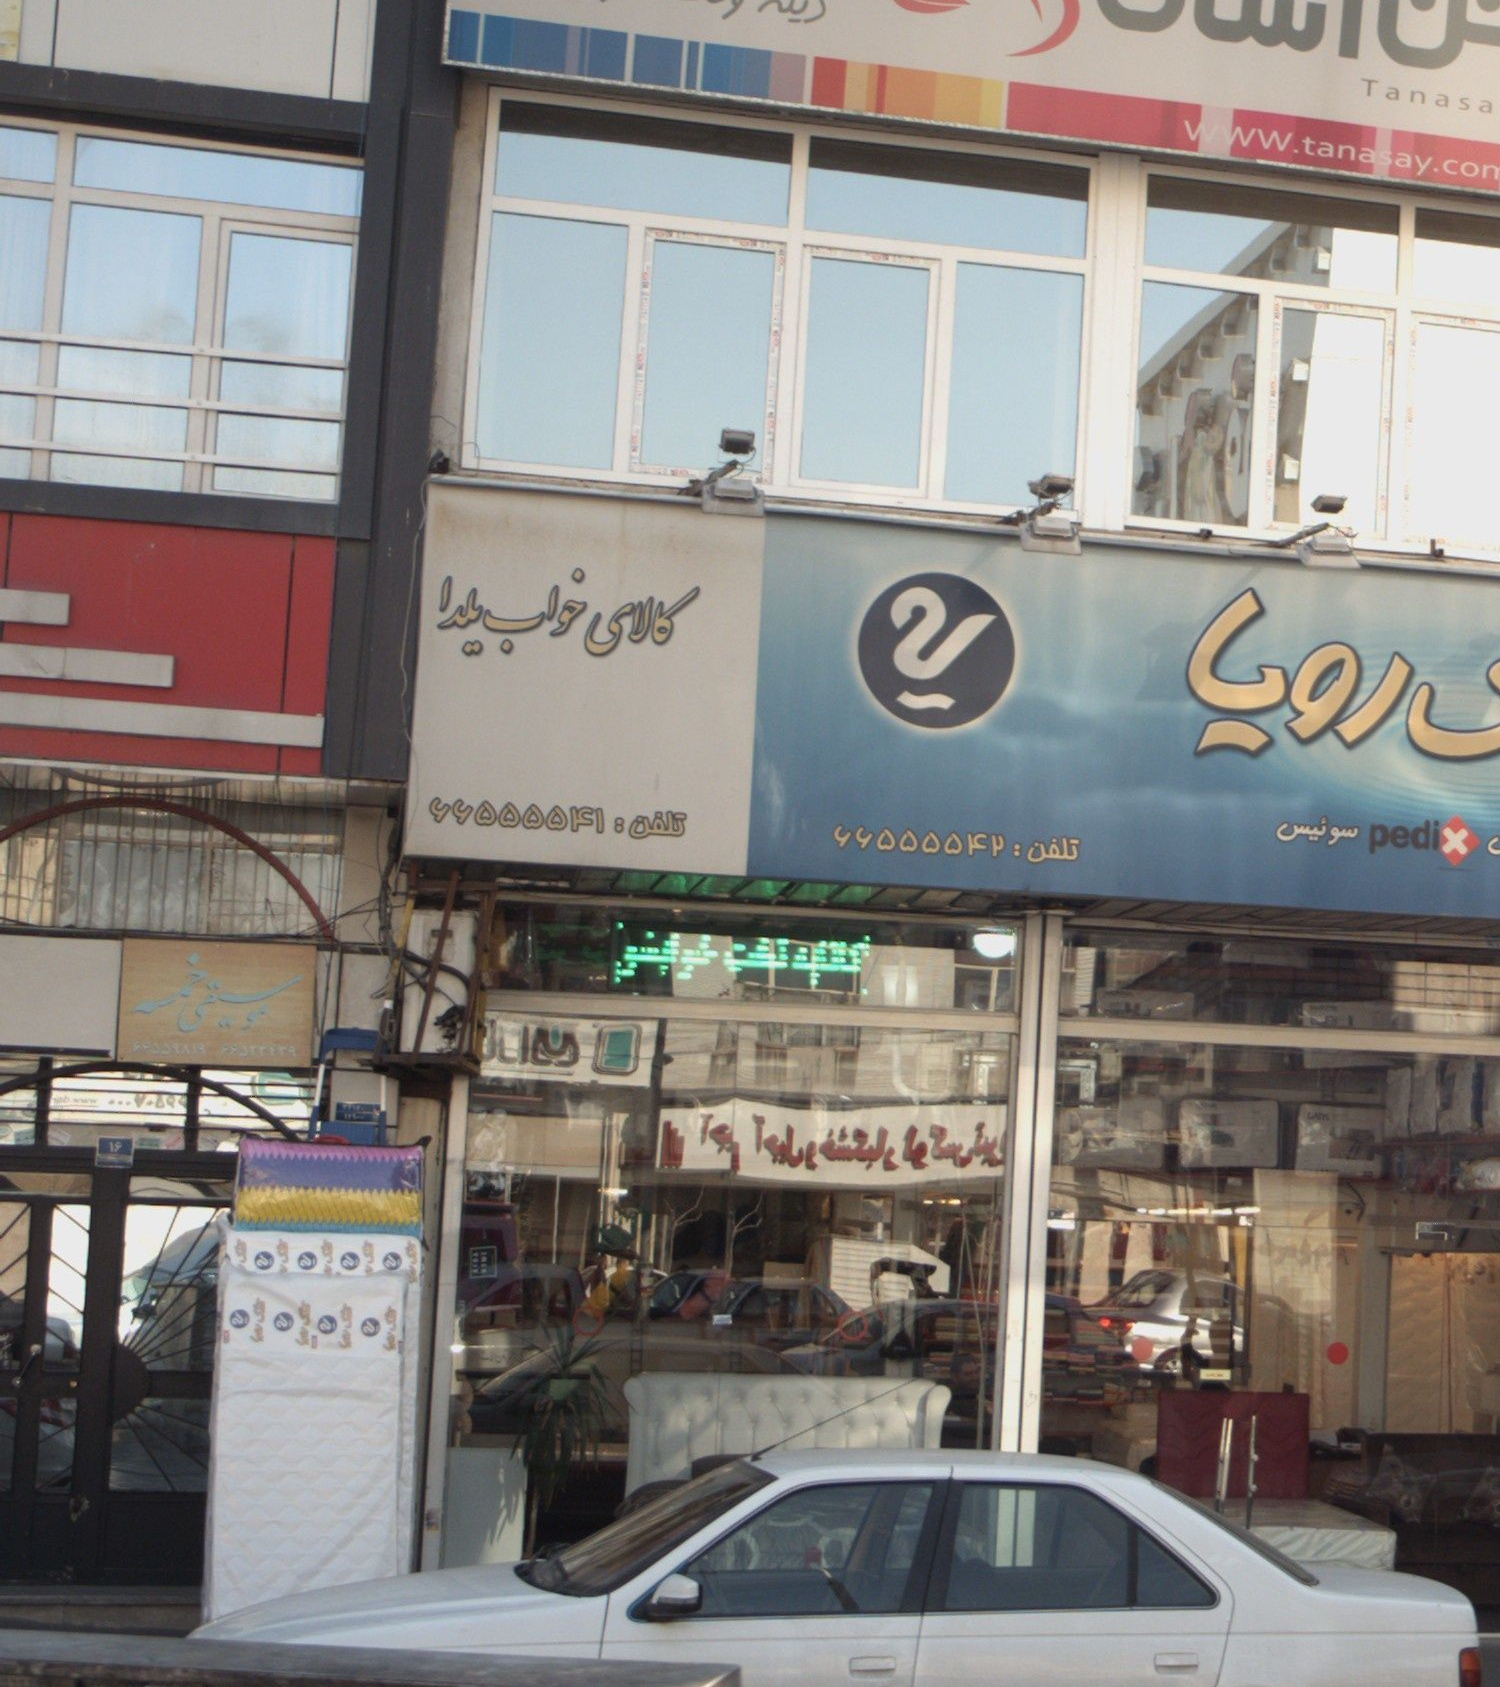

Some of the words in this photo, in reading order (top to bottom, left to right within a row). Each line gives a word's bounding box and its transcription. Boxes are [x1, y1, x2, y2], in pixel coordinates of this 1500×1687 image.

[437, 575, 484, 656] یلدا
[482, 567, 588, 655] خواب
[585, 586, 701, 657] کالای
[1186, 587, 1414, 758] رویا
[429, 796, 605, 834] ۶۶۵۵۵۵۴۱
[833, 824, 1006, 858] ۶۶۵۵۵۵۴۲
